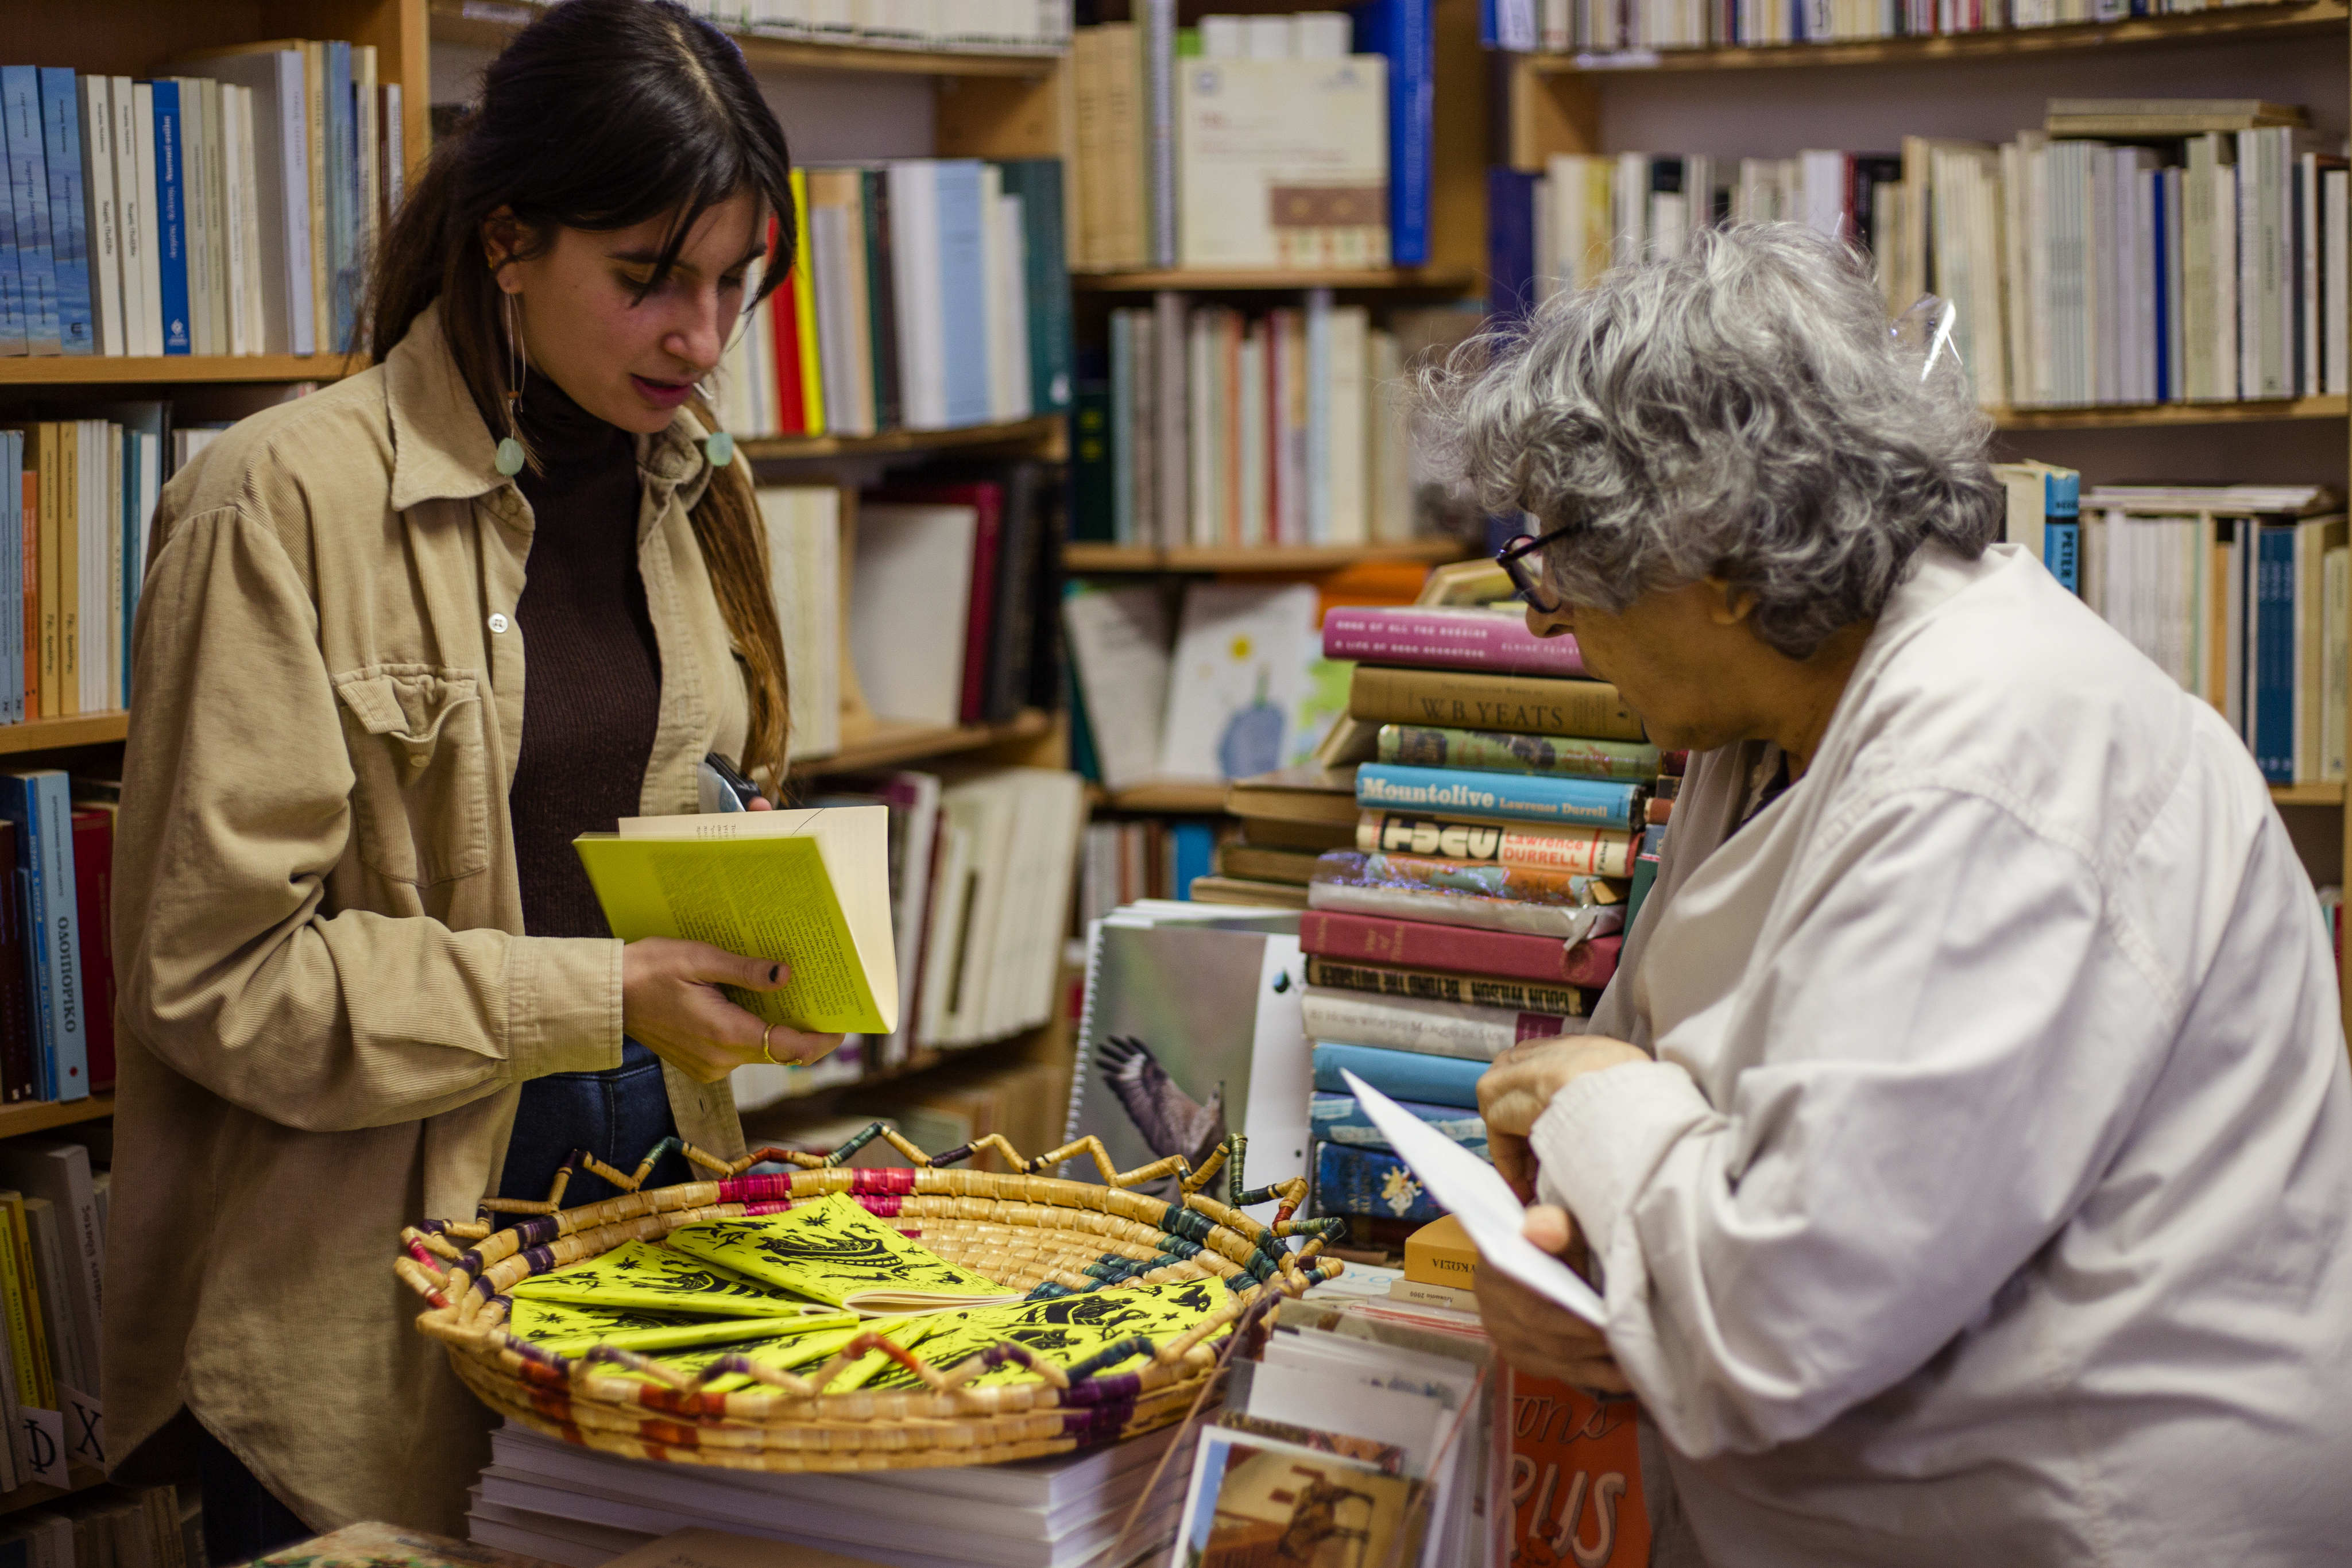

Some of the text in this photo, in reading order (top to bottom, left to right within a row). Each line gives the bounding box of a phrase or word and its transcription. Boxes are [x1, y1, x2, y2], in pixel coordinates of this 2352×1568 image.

[1476, 701, 1564, 729] YEATS
[1361, 777, 1608, 818] Mountolive Lawrence Durrell
[1505, 830, 1584, 851] Lawrence
[1503, 847, 1580, 868] DURRELL
[767, 938, 776, 950] μέσα
[57, 916, 76, 1033] ΟΔΟΙΠΟΡΙΚΟ
[1433, 1259, 1476, 1273] ΥΚΩΣΙΑ
[1513, 1393, 1623, 1442] ons
